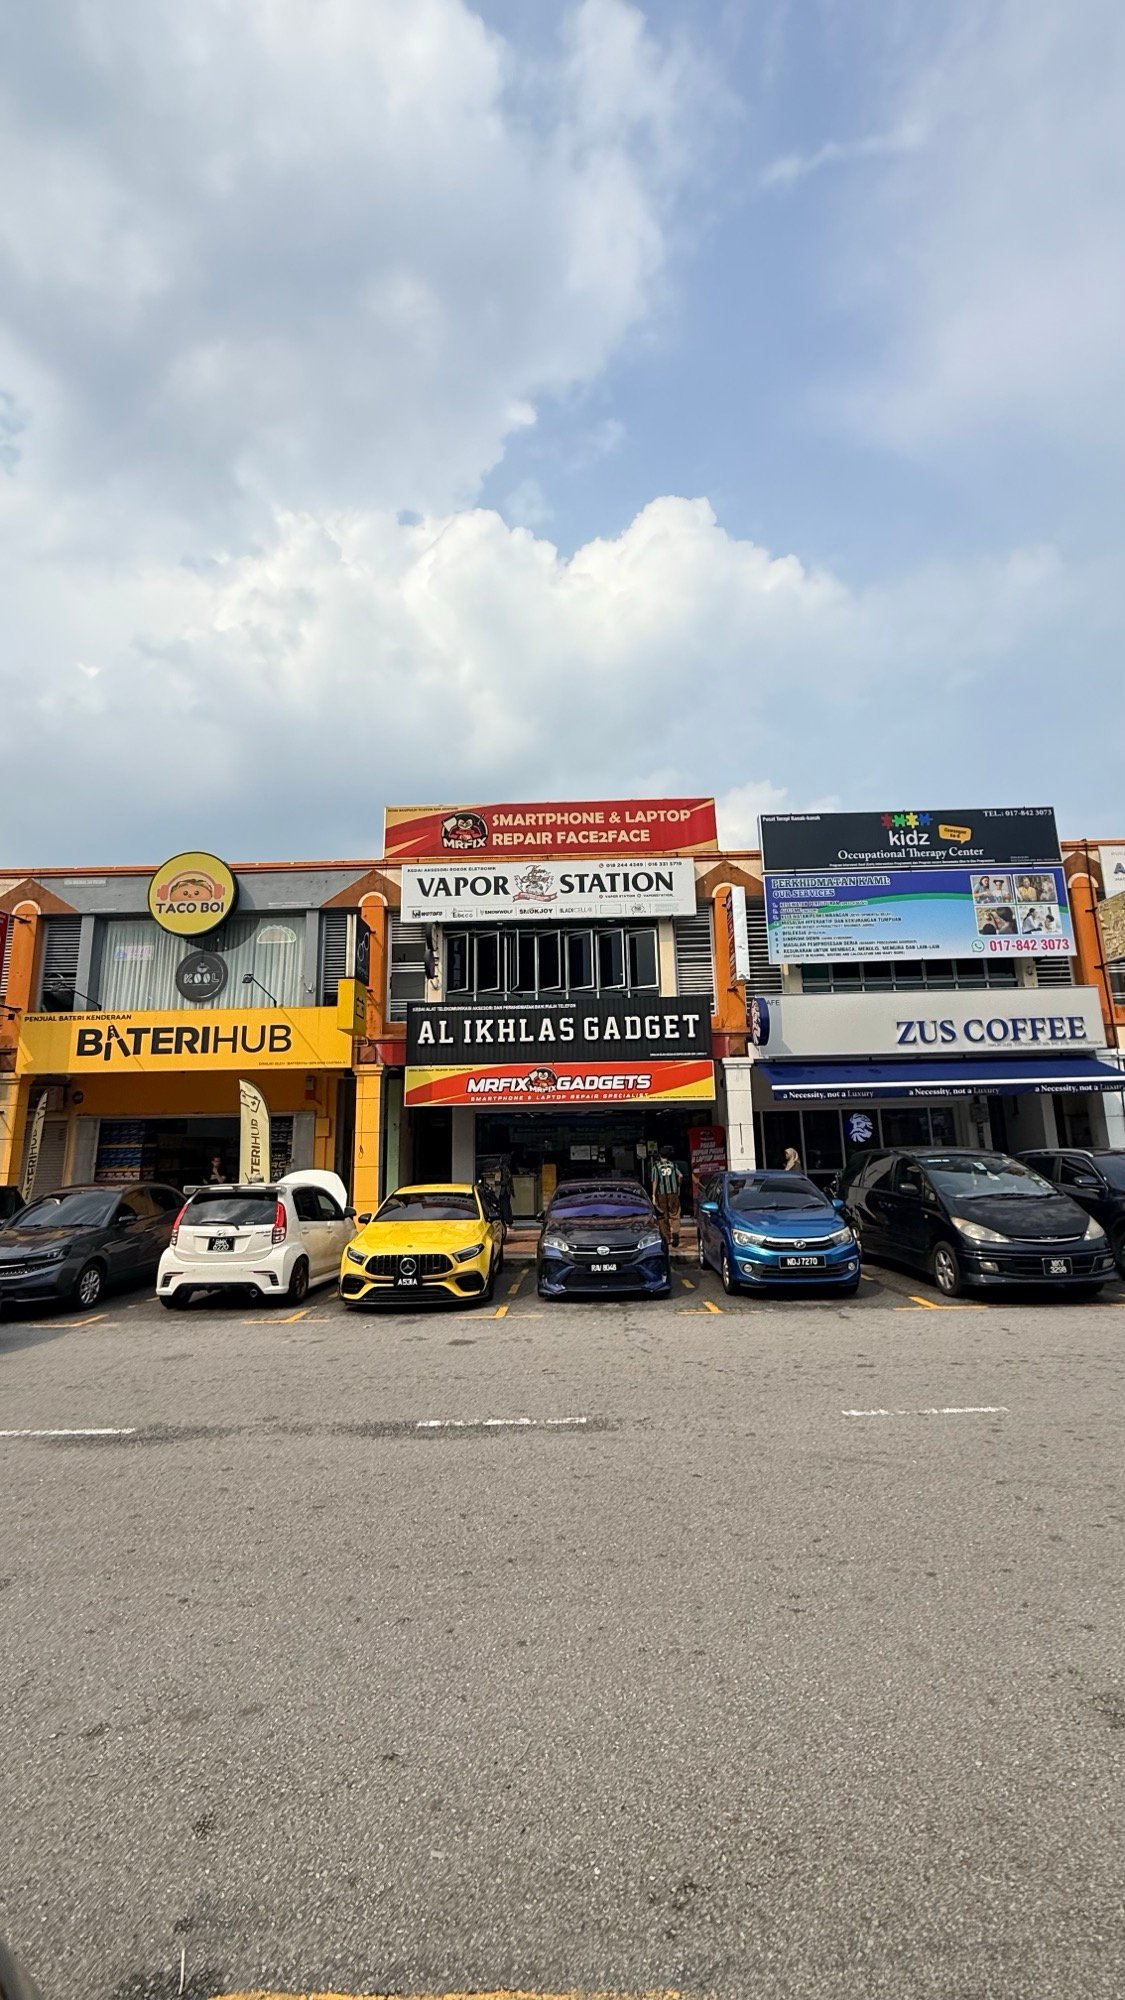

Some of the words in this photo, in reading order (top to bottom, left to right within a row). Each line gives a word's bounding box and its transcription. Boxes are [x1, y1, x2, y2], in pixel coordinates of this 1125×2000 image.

[492, 811, 605, 826] SMARTPHONE
[608, 811, 621, 824] &
[625, 809, 691, 823] LAPTOP
[1005, 809, 1034, 817] 017-842
[443, 837, 487, 849] MRFIX
[492, 831, 552, 846] REPAIR
[557, 829, 650, 844] FACE2FACE
[888, 830, 931, 846] kidz
[838, 848, 906, 862] Occupational
[907, 848, 947, 860] Therapy
[948, 846, 984, 857] Center
[417, 875, 511, 897] VAPOR
[560, 871, 674, 894] STATION
[772, 877, 856, 888] PERKHIDMATAN
[858, 876, 890, 886] KAMI:
[773, 890, 791, 898] OUR
[791, 888, 835, 898] SERVICES
[156, 902, 197, 914] TACO
[200, 902, 224, 913] BOI
[989, 940, 1037, 951] 017-842
[1041, 938, 1070, 950] 3073
[417, 1020, 454, 1044] AL
[463, 1017, 575, 1043] IKHLAS
[583, 1014, 700, 1041] GADGET
[896, 1019, 957, 1045] ZUS
[963, 1016, 1087, 1043] COFFEE
[76, 1024, 292, 1061] BATERIHUB
[467, 1077, 530, 1093] MRFIX
[556, 1075, 652, 1090] GADGETS
[1041, 1084, 1078, 1093] Necessity,
[789, 1090, 826, 1099] Necessity,
[847, 1090, 874, 1098] Luxury
[915, 1088, 952, 1096] Necessity,
[661, 1167, 672, 1176] 39
[786, 1258, 800, 1266] NDJ
[801, 1257, 818, 1266] 7270
